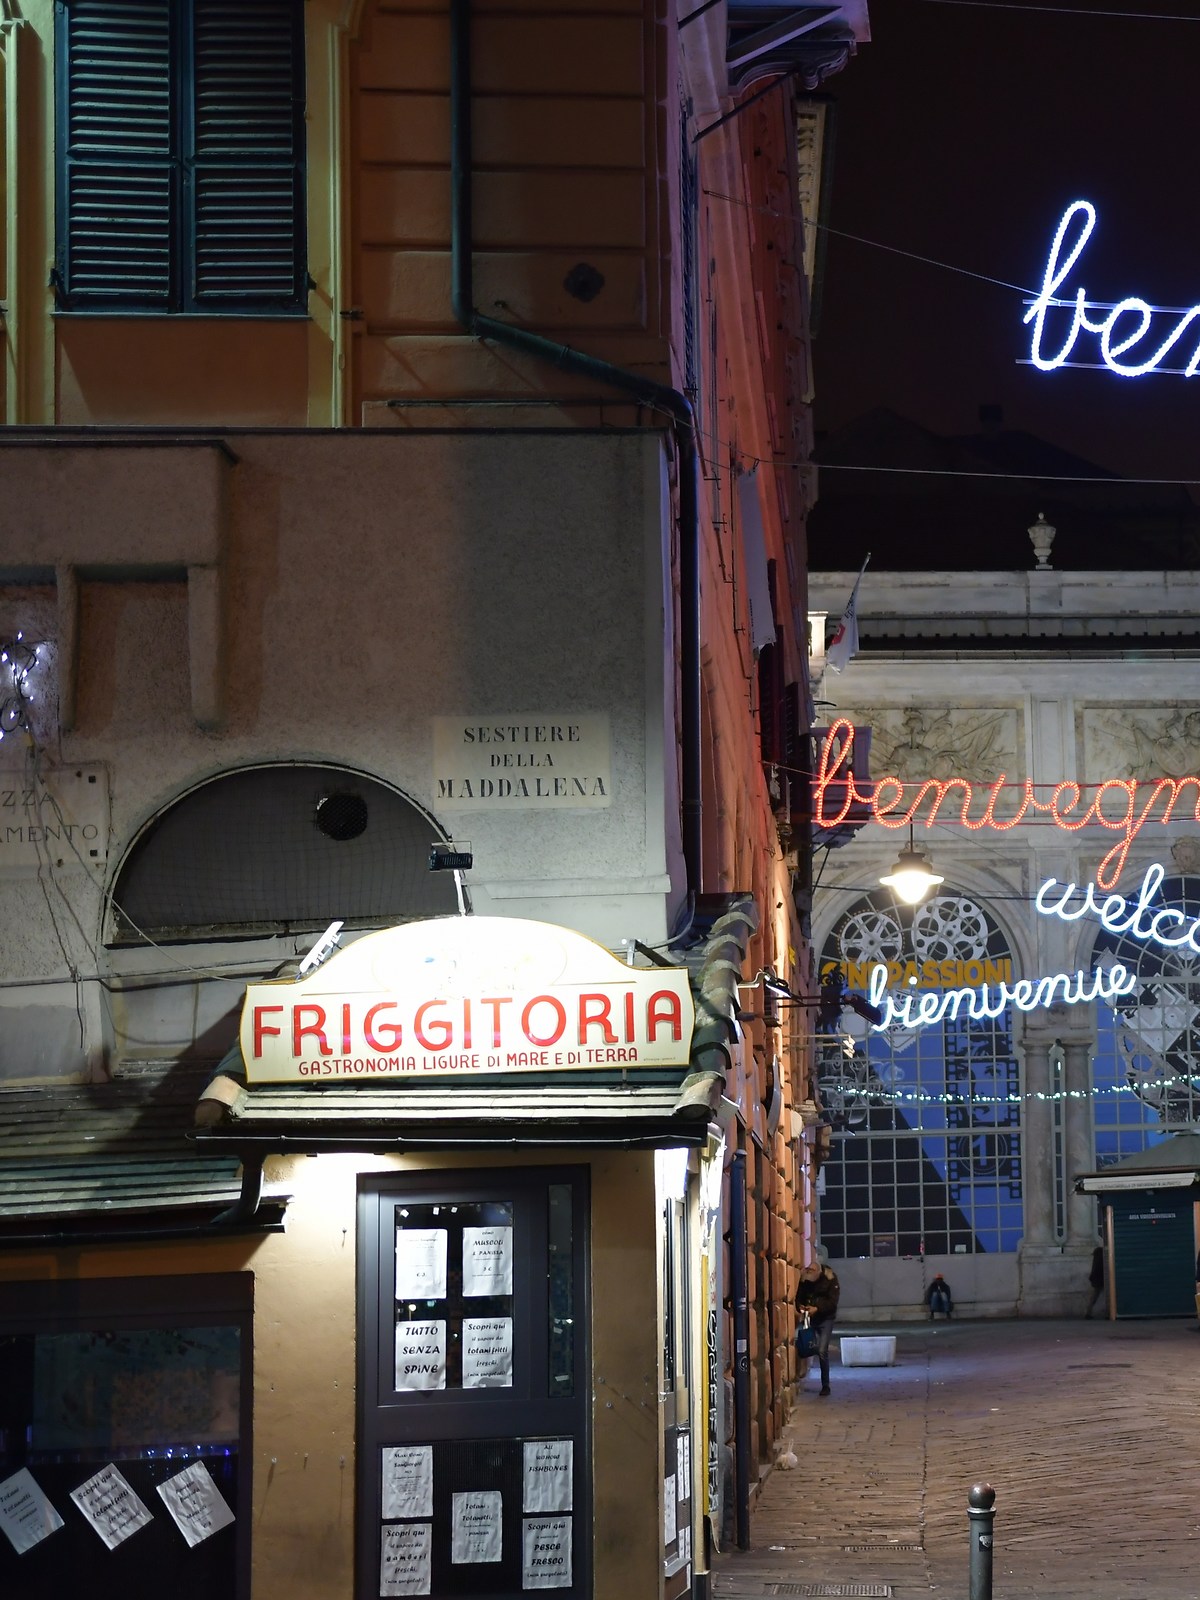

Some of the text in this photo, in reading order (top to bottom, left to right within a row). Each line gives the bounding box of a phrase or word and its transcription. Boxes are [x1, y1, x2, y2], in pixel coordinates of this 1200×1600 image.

[463, 725, 580, 744] SESTIERE
[490, 753, 555, 767] DELLA
[437, 777, 608, 799] MADDALENA
[0, 824, 98, 843] MENTO
[869, 962, 1137, 1033] bienvenue
[252, 989, 683, 1058] FRIGGITORIA
[299, 1047, 638, 1076] GASTRONOMIA LIGURE DI MARE E DI TERRA
[405, 1326, 439, 1336] TUTTO
[468, 1322, 506, 1331] Scopri qui
[402, 1345, 441, 1355] SENZA
[527, 1523, 551, 1531] Scopri
[386, 1529, 411, 1538] Scopri
[534, 1543, 561, 1551] PESCE
[531, 1557, 564, 1566] FRESCO
